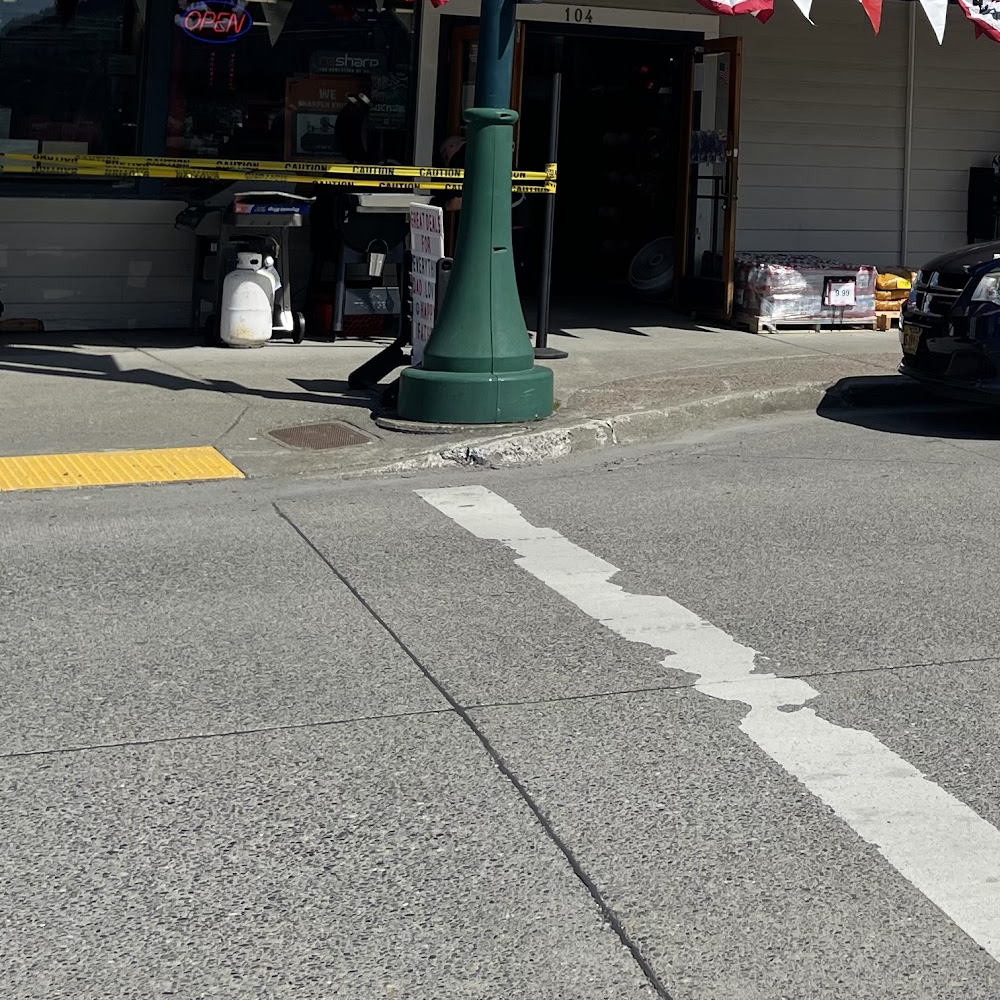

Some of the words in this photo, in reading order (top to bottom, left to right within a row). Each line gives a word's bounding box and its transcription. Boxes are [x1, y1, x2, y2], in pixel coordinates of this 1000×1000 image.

[184, 10, 246, 34] OPEN
[565, 7, 593, 24] 104
[319, 88, 337, 99] WE
[216, 160, 259, 169] CAUTION
[285, 163, 328, 172] CAUTION
[352, 165, 394, 176] CAUTION
[420, 168, 461, 178] CAUTION
[379, 182, 420, 190] CAUTION
[421, 235, 431, 254] FOR
